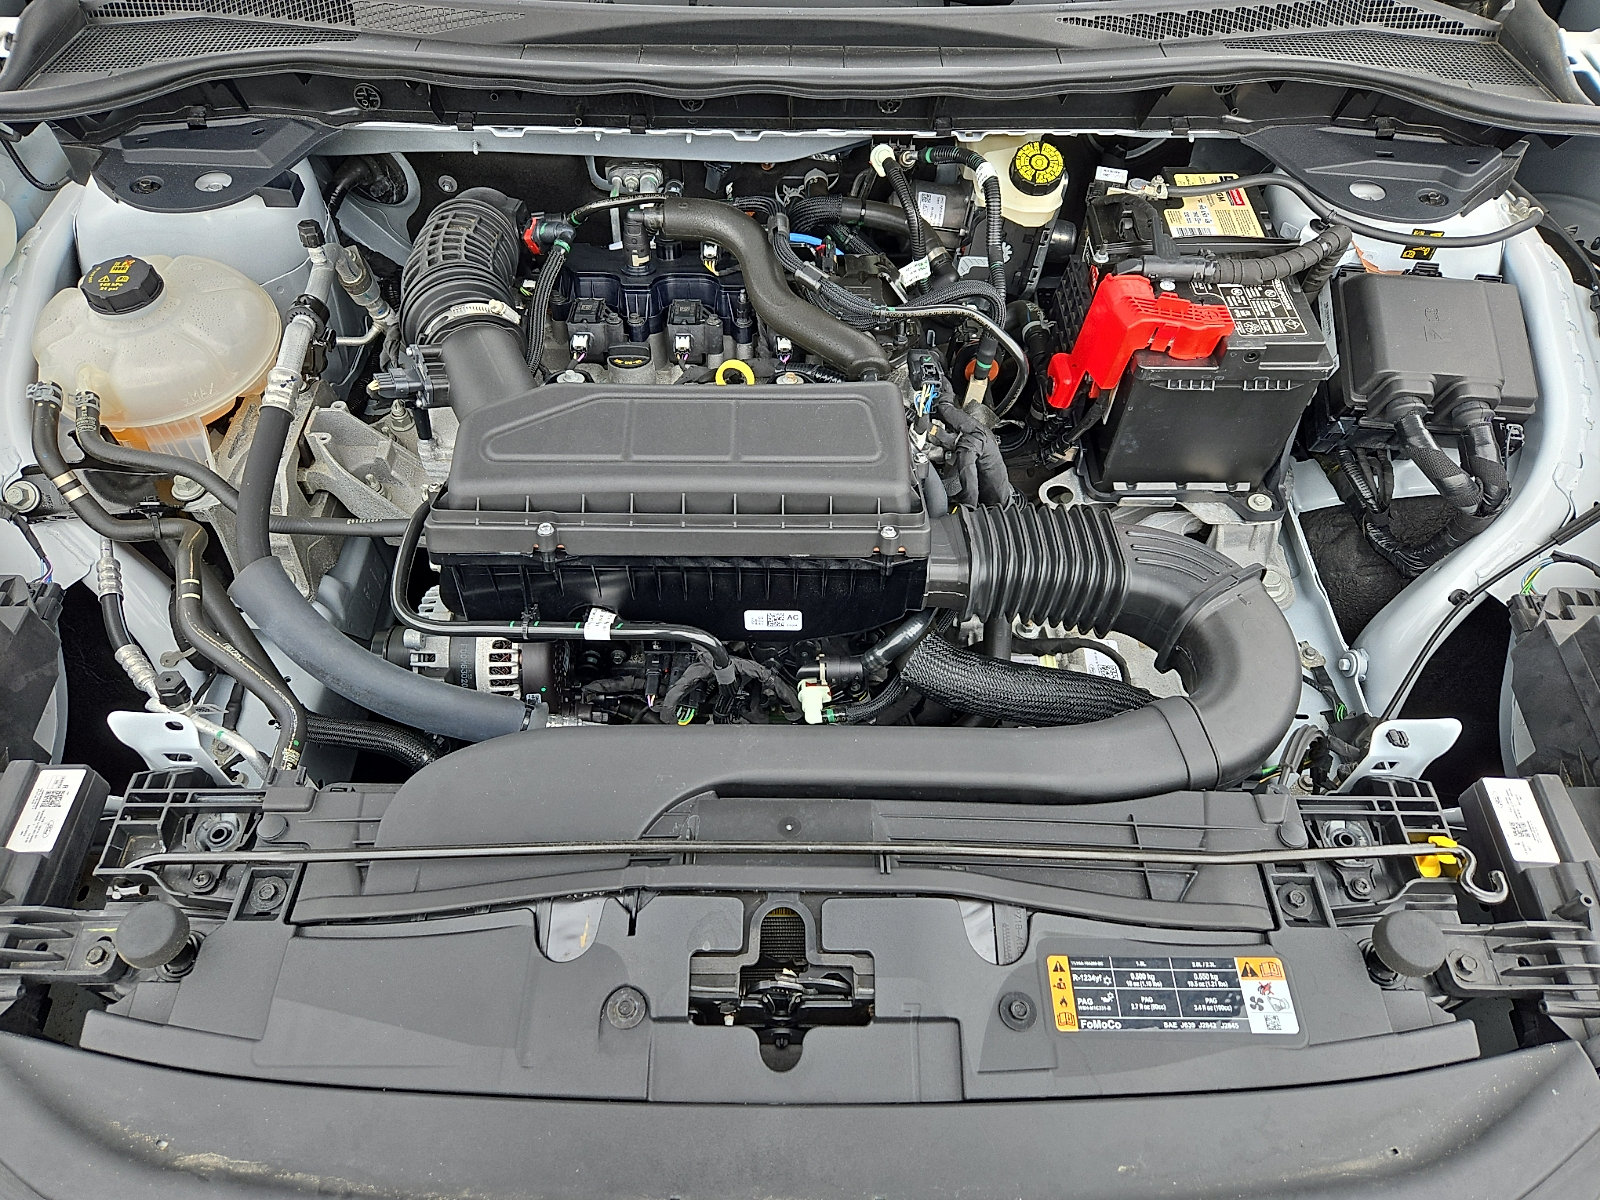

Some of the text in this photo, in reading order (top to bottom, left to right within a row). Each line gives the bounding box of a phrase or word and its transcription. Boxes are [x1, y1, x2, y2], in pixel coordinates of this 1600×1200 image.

[1072, 973, 1102, 983] R-1234yf
[1077, 997, 1093, 1005] PAG
[1080, 1019, 1122, 1029] FoMoCo
